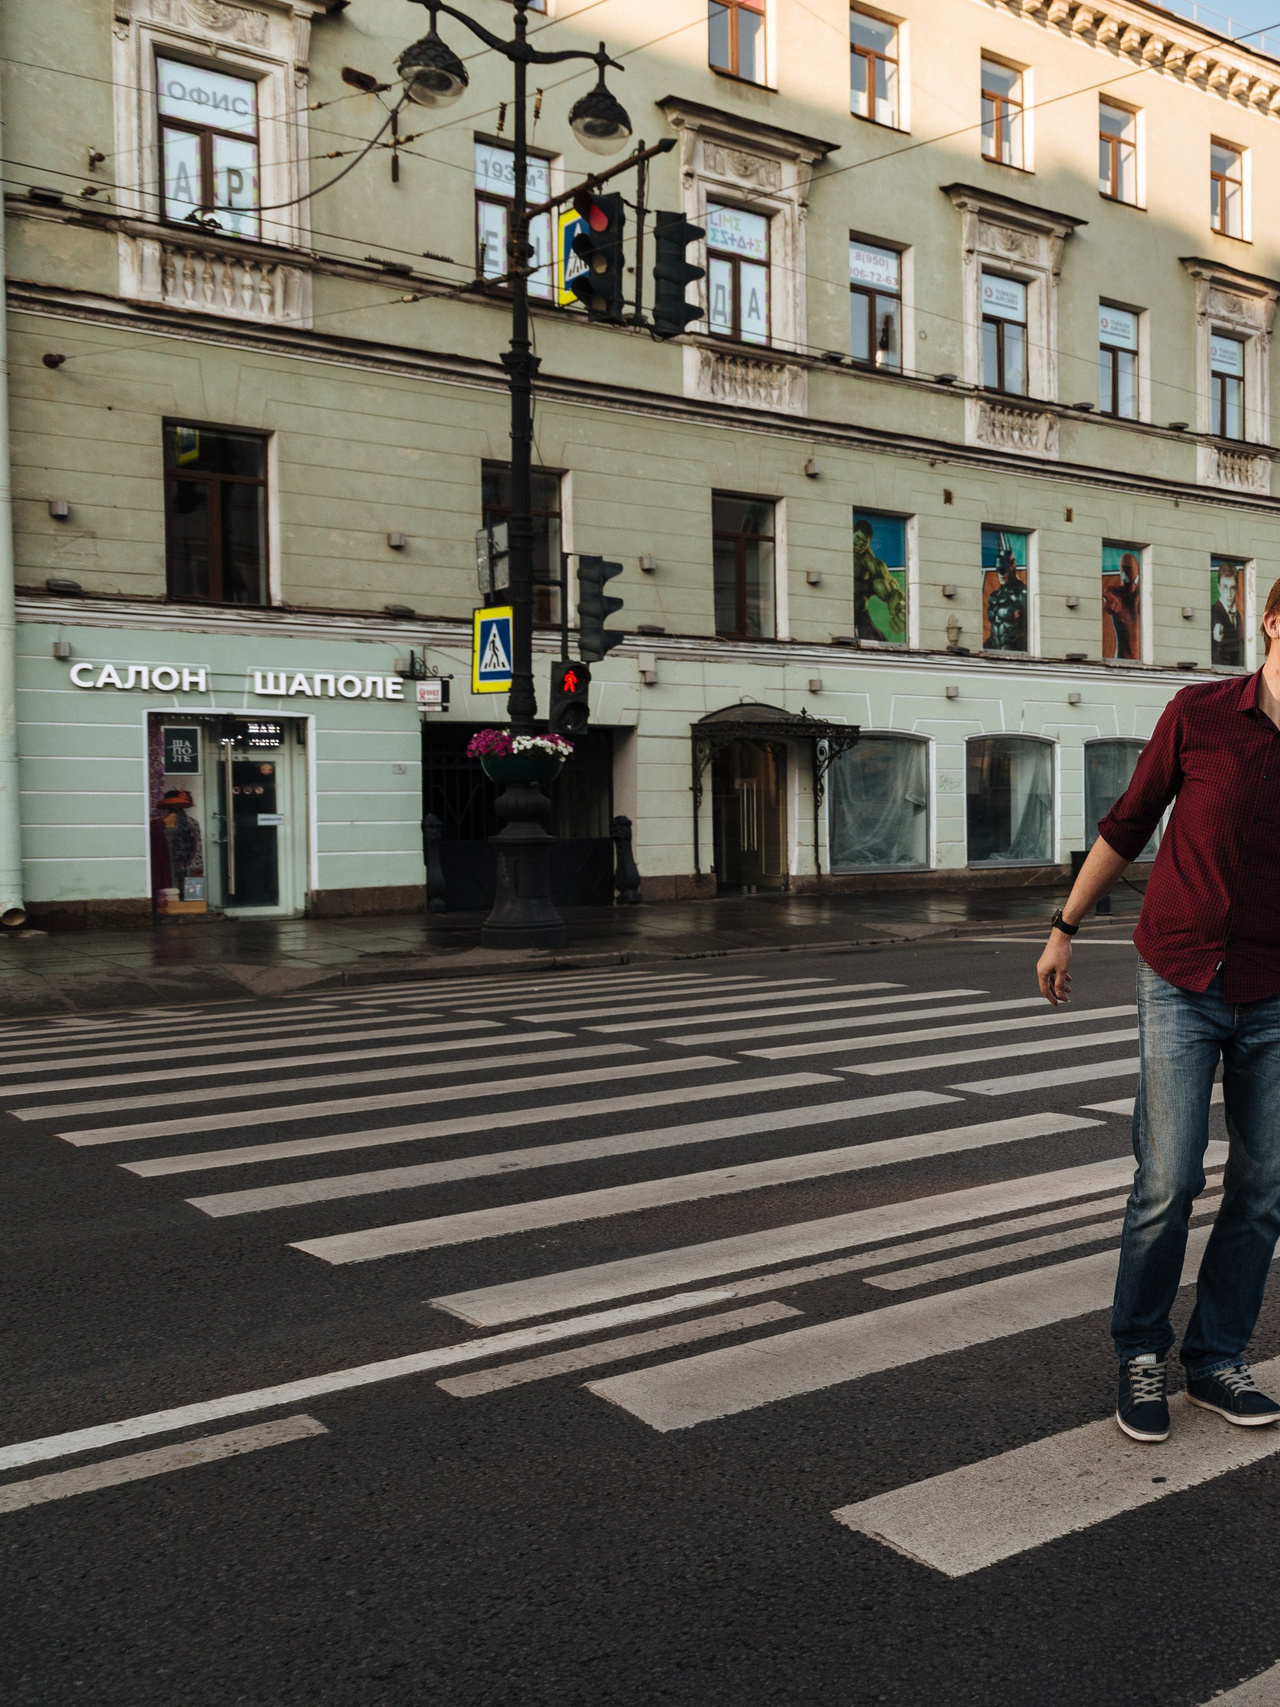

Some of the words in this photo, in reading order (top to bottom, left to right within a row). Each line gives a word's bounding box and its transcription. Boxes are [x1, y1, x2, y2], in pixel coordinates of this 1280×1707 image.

[167, 81, 249, 117] ОФИС
[481, 159, 515, 183] 193
[855, 251, 889, 271] 8(950)
[69, 662, 207, 693] САЛОН
[254, 670, 405, 700] ШАПОЛЕ
